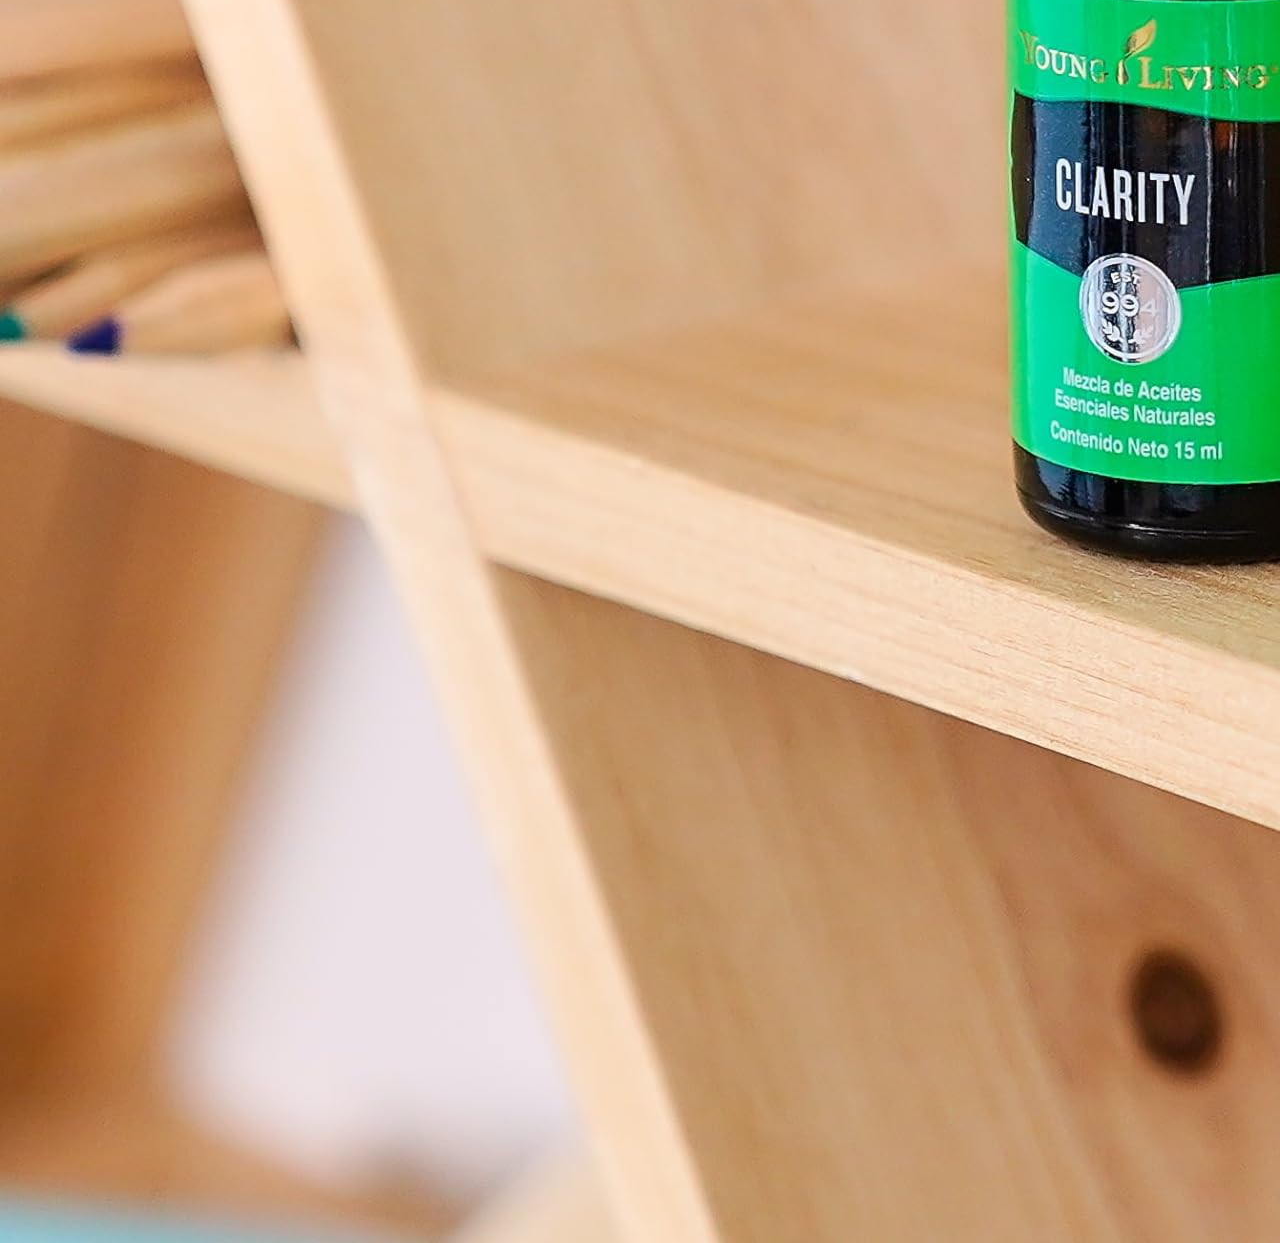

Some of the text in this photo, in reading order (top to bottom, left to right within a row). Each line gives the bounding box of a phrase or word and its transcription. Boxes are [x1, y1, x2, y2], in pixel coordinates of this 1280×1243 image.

[1019, 29, 1109, 84] YOUNG
[1055, 157, 1196, 226] CLARITY
[1110, 271, 1140, 285] EST
[1096, 290, 1159, 317] 994
[1063, 367, 1202, 402] Mezcla de Aceites
[1055, 388, 1216, 427] Esenciales Naturales
[1050, 420, 1223, 460] Contenido Neto 15 ml
